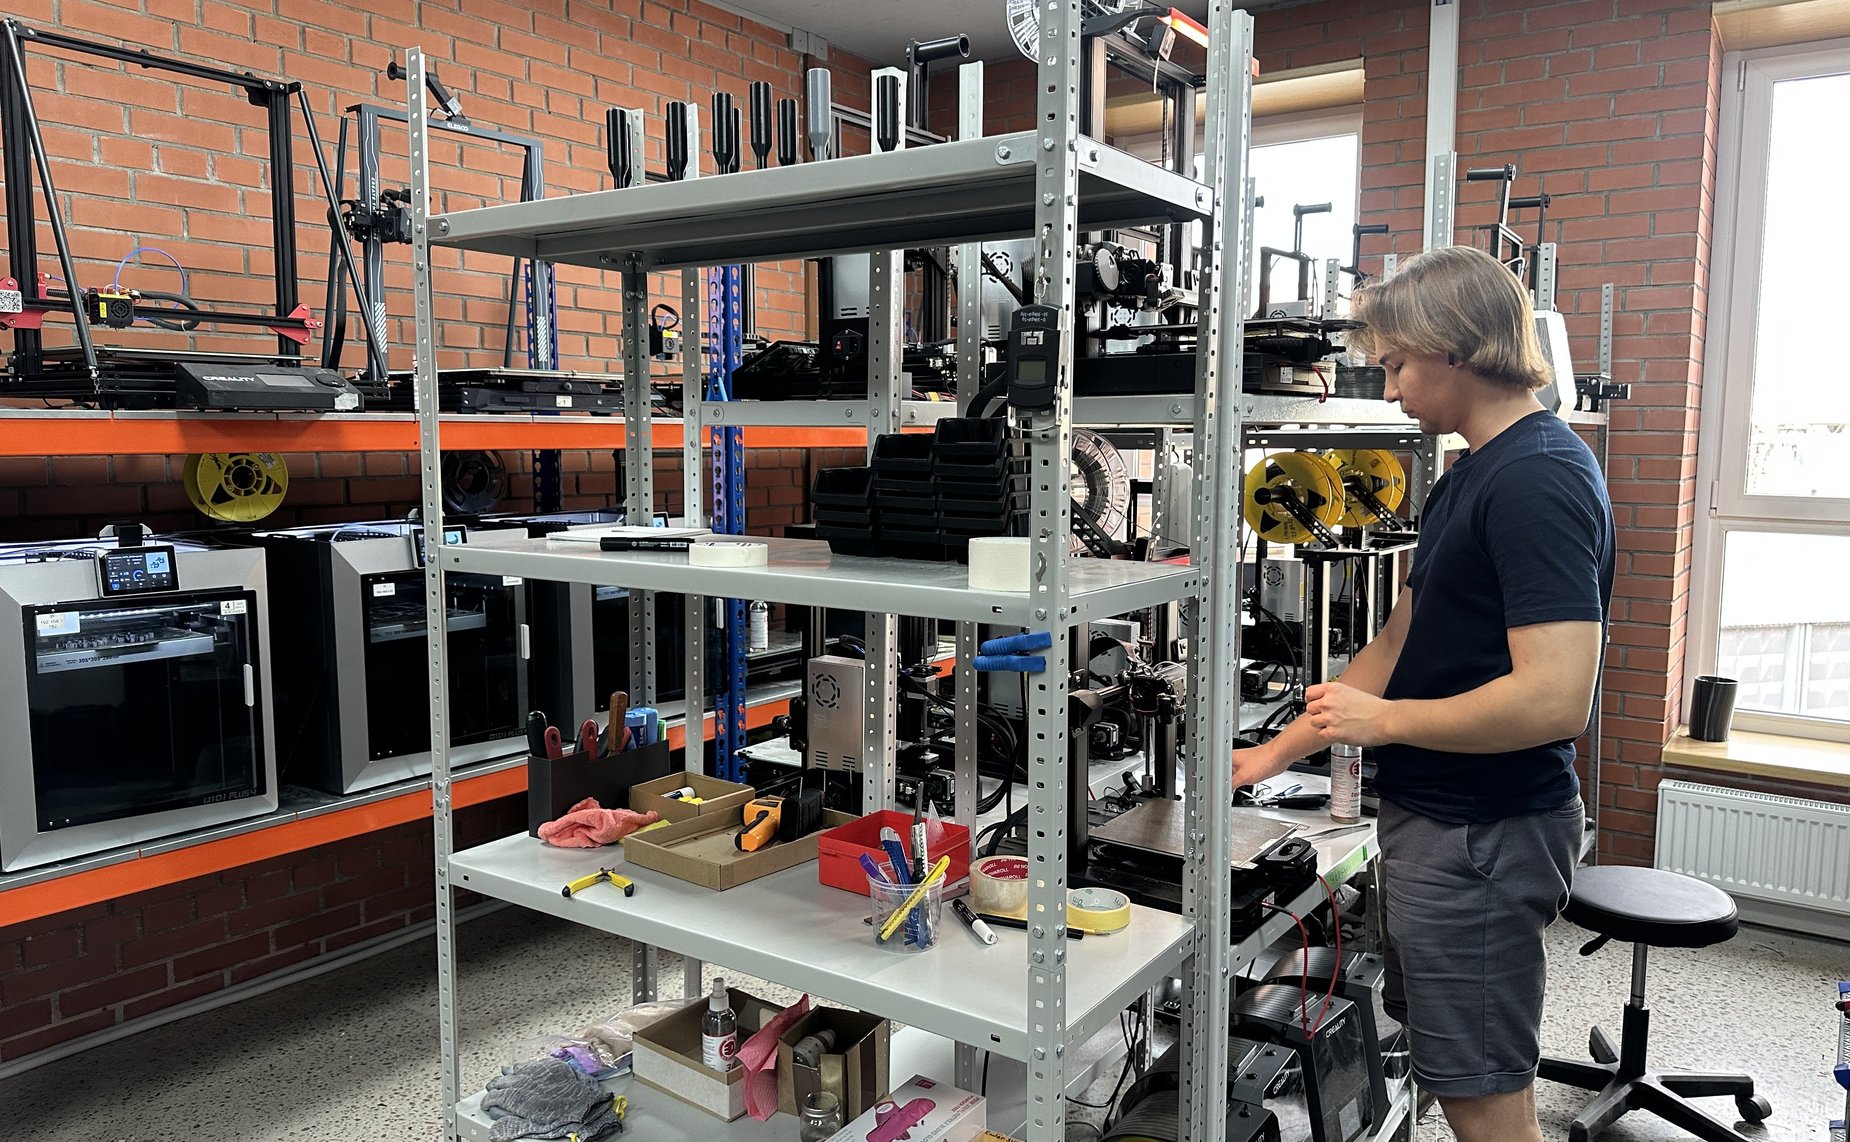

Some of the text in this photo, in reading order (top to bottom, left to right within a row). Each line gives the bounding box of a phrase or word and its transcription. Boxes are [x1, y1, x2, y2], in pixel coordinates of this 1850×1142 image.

[447, 122, 469, 131] ELEGOO
[203, 793, 227, 803] QIDI
[1325, 1016, 1346, 1038] CREALITY
[1273, 1069, 1289, 1095] CREALITY
